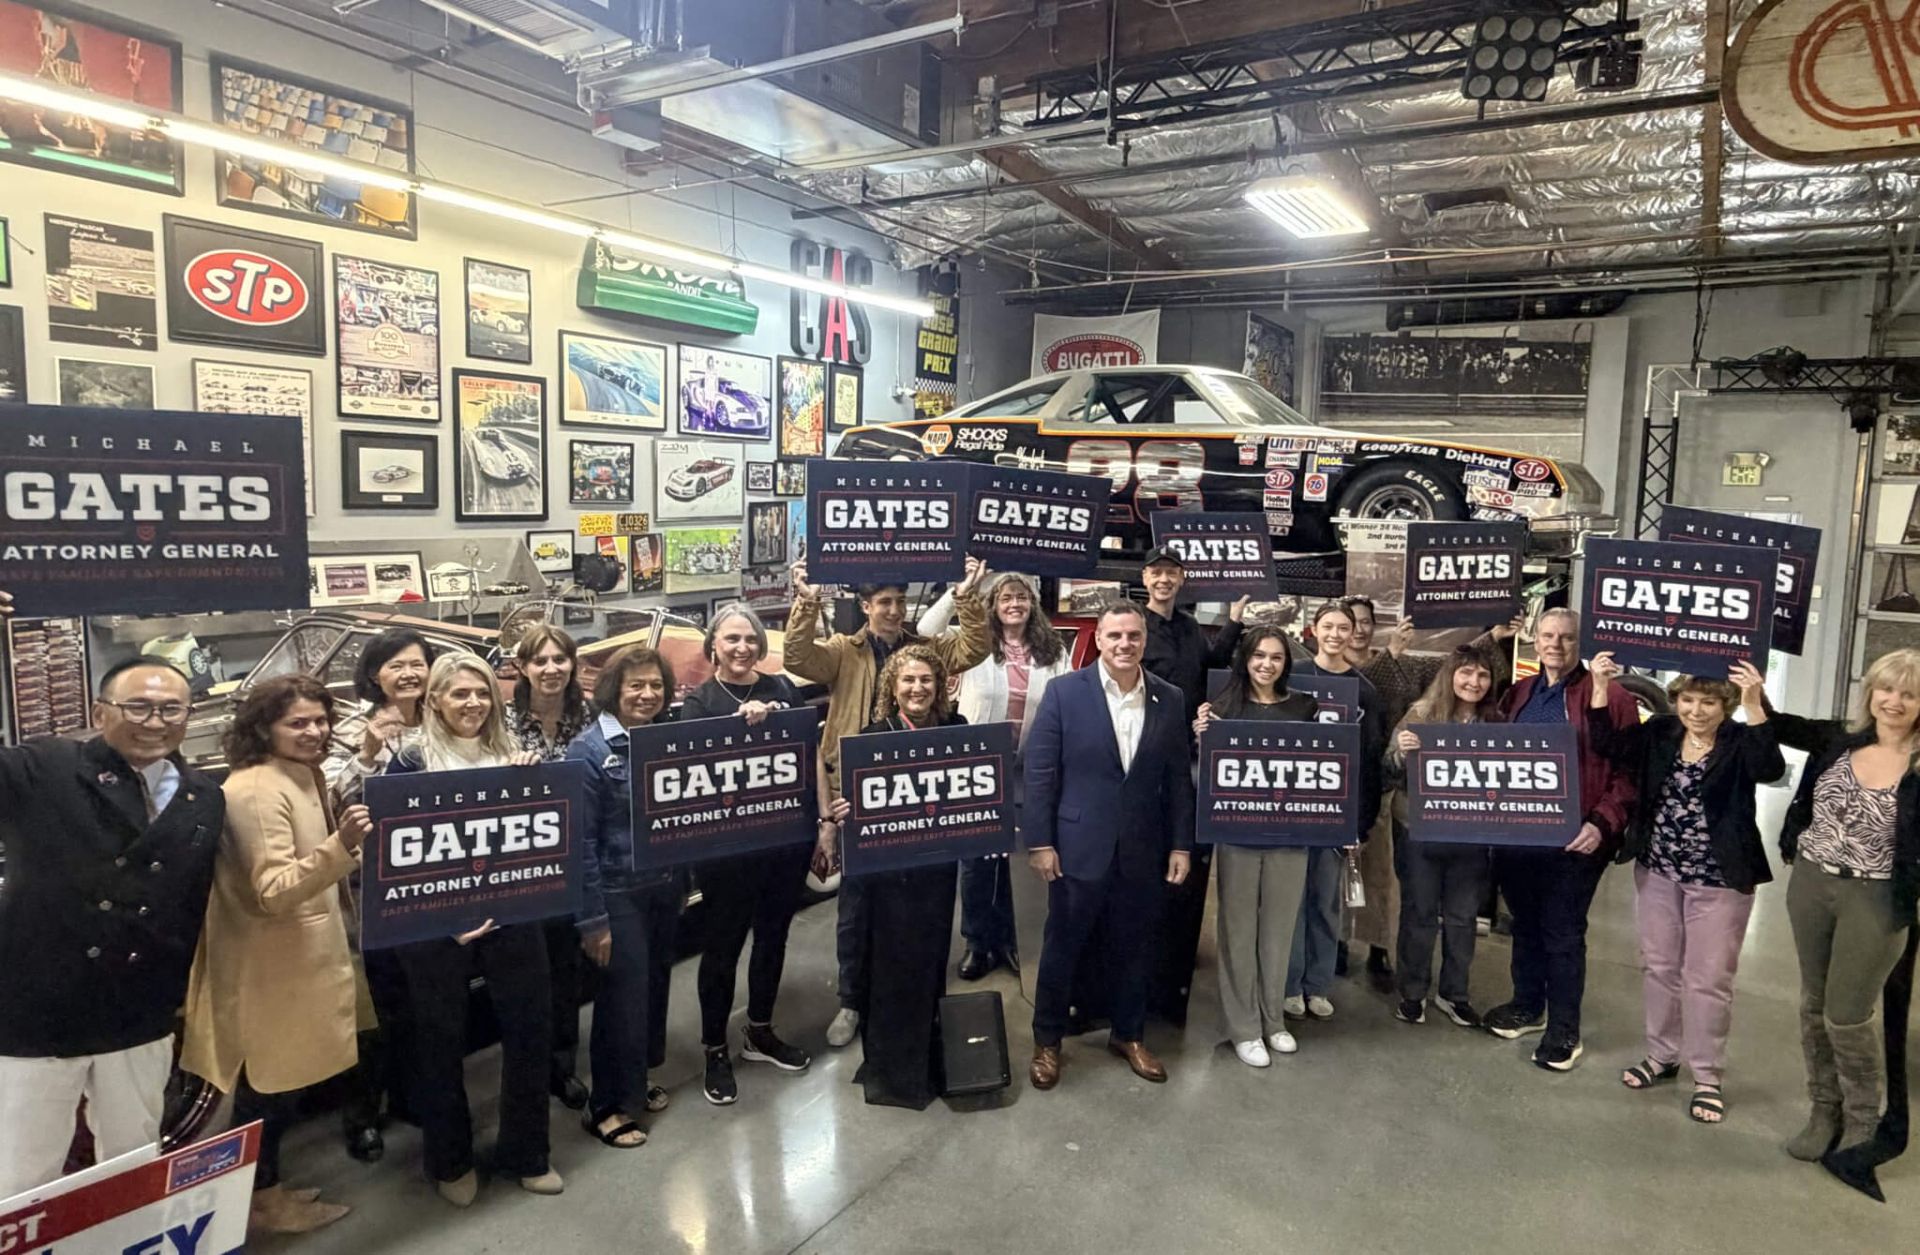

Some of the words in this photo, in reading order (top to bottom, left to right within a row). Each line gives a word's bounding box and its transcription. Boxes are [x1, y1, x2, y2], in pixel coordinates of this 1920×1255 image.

[202, 259, 293, 315] STP
[1057, 351, 1132, 369] BUGATTI
[927, 432, 948, 446] NAPA
[957, 428, 1009, 441] SHOCKS
[29, 435, 254, 453] MICHAEL
[954, 441, 981, 451] Regal
[983, 441, 1005, 451] Ride
[1361, 443, 1439, 457] GOODYEAR
[1269, 455, 1298, 463] CHAMPION
[1318, 457, 1343, 466] MOOG
[1445, 449, 1512, 469] DieHard
[1518, 462, 1545, 477] STP
[837, 478, 942, 487] MICHAEL
[1269, 472, 1292, 486] STP
[1310, 480, 1322, 490] 76
[1404, 470, 1446, 502] EAGLE
[1465, 473, 1507, 490] BUSCH
[5, 471, 270, 521] GATES
[993, 481, 1087, 497] MICHAEL
[1265, 496, 1290, 504] Holley
[825, 499, 949, 529] GATES
[978, 498, 1090, 532] GATES
[973, 533, 1033, 546] ATTORNEY
[1036, 539, 1087, 551] GENERAL
[1429, 536, 1507, 545] MICHAEL
[1686, 524, 1791, 550] MICHAEL
[3, 544, 152, 560] ATTORNEY
[163, 543, 279, 558] GENERAL
[822, 542, 891, 552] ATTORNEY
[894, 542, 952, 551] GENERAL
[1168, 539, 1260, 561] GATES
[1184, 570, 1220, 578] TORNEY
[1223, 570, 1265, 578] GENERAL
[1419, 554, 1510, 581] GATES
[1617, 556, 1743, 575] MICHAEL
[1416, 591, 1466, 601] ATTORNEY
[1468, 590, 1512, 599] GENERAL
[1601, 577, 1749, 620] GATES
[1596, 620, 1673, 637] ATTORNEY
[1678, 628, 1751, 646] GENERAL
[667, 730, 789, 752] MICHAEL
[1230, 737, 1335, 748] MICHAEL
[1437, 739, 1549, 748] MICHAEL
[874, 742, 987, 761] MICHAEL
[654, 752, 797, 802] GATES
[1217, 758, 1341, 790] GATES
[1425, 759, 1558, 790] GATES
[408, 785, 552, 808] MICHAEL
[862, 765, 996, 810] GATES
[651, 808, 733, 830] ATTORNEY
[736, 797, 802, 816] GENERAL
[1213, 800, 1281, 812] ATTORNEY
[1285, 801, 1343, 813] GENERAL
[1424, 800, 1495, 811] ATTORNEY
[1499, 801, 1563, 813] GENERAL
[860, 817, 935, 836] ATTORNEY
[938, 810, 1000, 825] GENERAL
[390, 811, 560, 867] GATES
[385, 875, 483, 900] ATTORNEY
[489, 864, 564, 885] GENERAL
